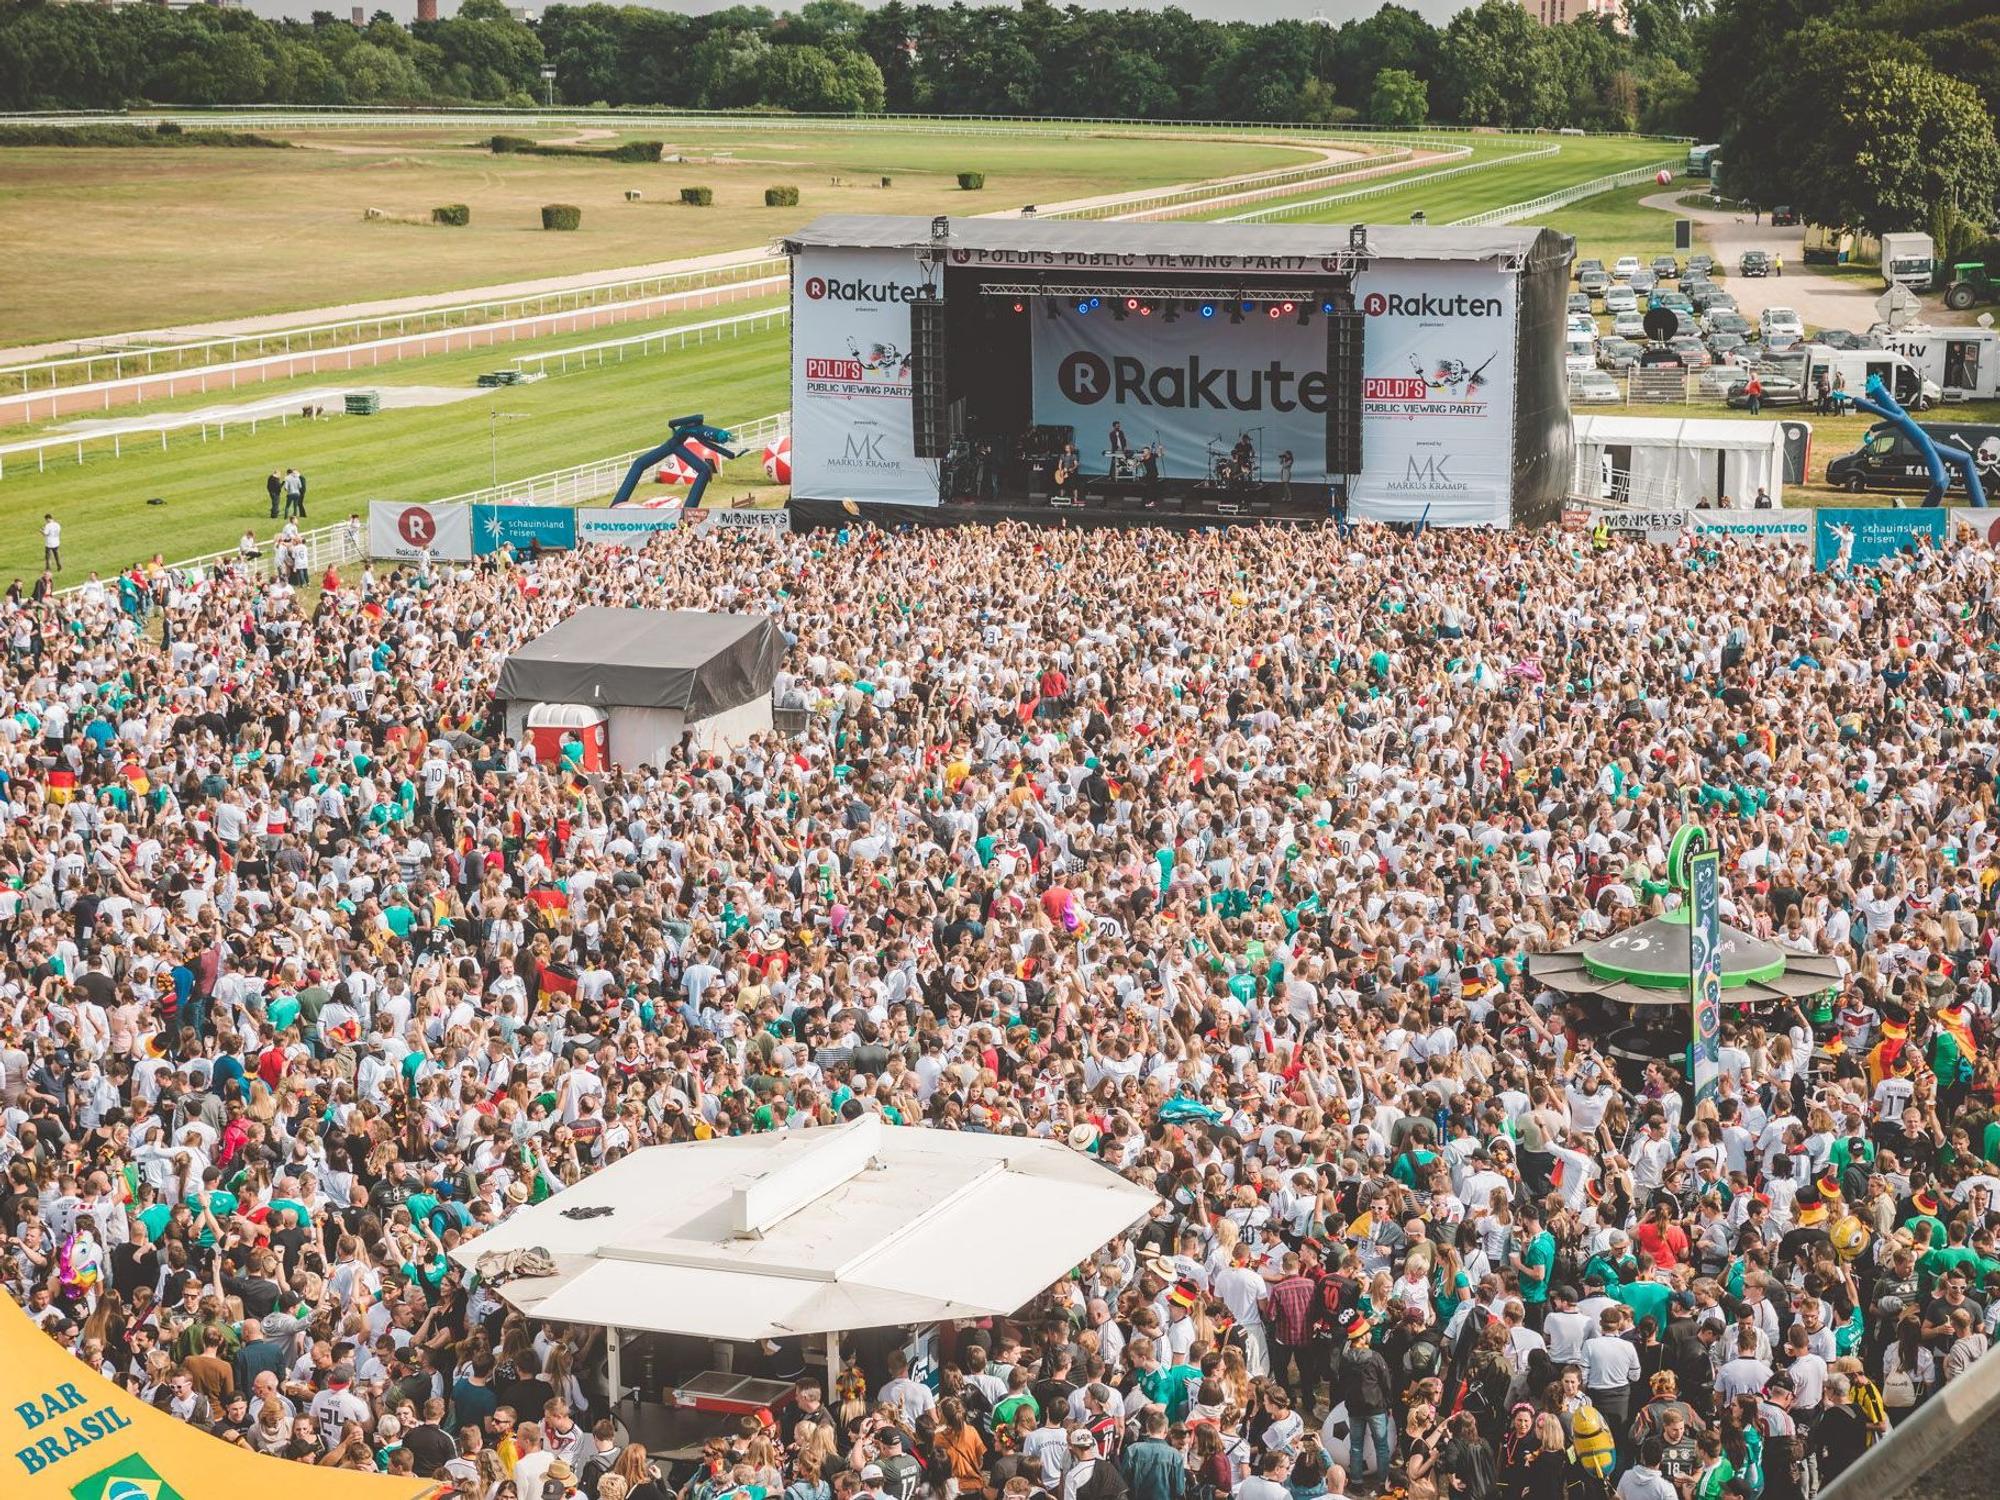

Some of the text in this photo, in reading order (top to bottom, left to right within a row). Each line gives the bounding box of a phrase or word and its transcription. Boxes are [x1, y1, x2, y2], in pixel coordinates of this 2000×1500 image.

[979, 250, 1054, 264] POLDI'S
[1064, 252, 1135, 266] PUBLIC
[1147, 254, 1232, 268] VIEWING
[1388, 293, 1502, 317] Rakuten
[808, 360, 861, 379] POLDI'S
[807, 383, 839, 392] PUBLIC
[842, 384, 882, 395] VIEWING
[1366, 380, 1425, 398] POLDI'S
[1364, 403, 1400, 413] PUBLIC
[1404, 404, 1446, 414] VIEWING
[1406, 454, 1452, 482] MK
[1386, 482, 1468, 491] MARKUS KRAMPE
[508, 520, 565, 529] schauinsland
[1705, 524, 1808, 535] POLYGONVATRO
[1862, 523, 1932, 533] schauinsland
[1862, 534, 1895, 543] reisen
[431, 768, 442, 782] 10
[1100, 922, 1116, 937] 20
[1324, 1286, 1339, 1311] 10
[15, 1382, 88, 1430] BAR
[320, 1408, 349, 1436] 24
[15, 1406, 132, 1475] BRASIL
[1667, 1461, 1680, 1476] 18
[901, 1475, 916, 1500] 17
